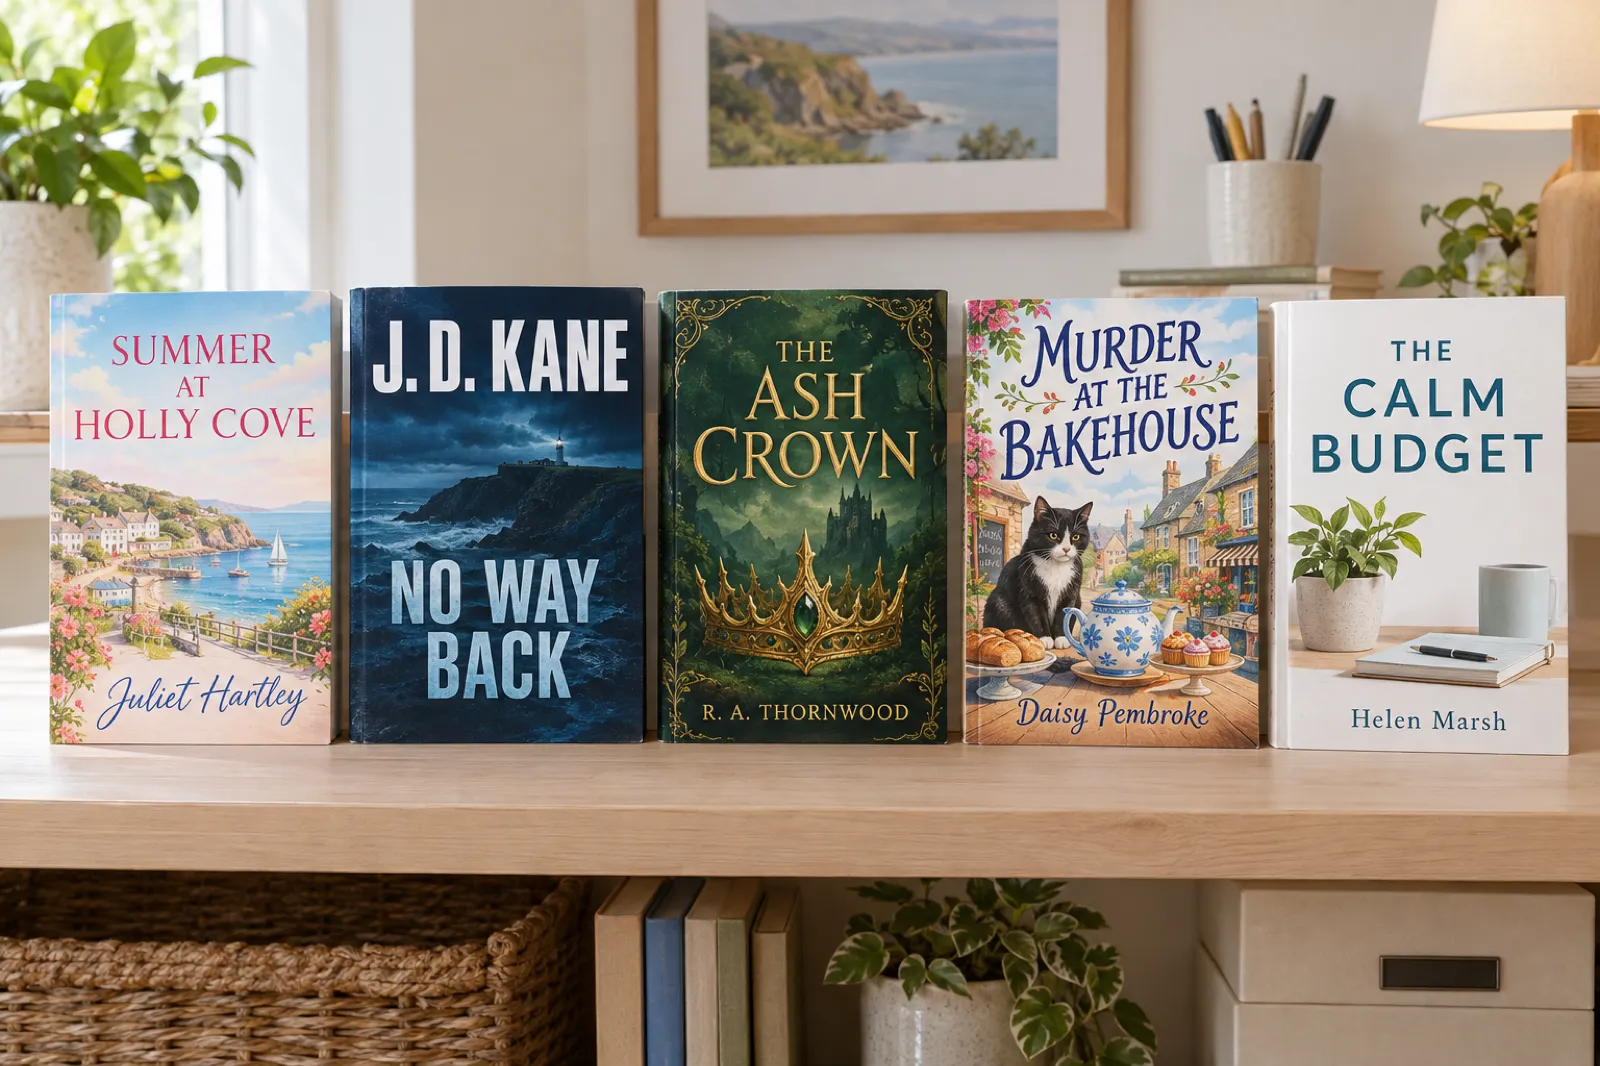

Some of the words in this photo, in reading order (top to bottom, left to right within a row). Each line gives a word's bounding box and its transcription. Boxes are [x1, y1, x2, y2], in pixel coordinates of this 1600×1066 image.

[111, 332, 275, 367] SUMMER
[371, 320, 417, 393] J.
[429, 320, 475, 393] D.
[492, 319, 629, 393] KANE
[775, 340, 834, 363] THE
[1020, 319, 1212, 388] MURDER
[1390, 339, 1452, 362] THE
[176, 375, 210, 398] AT
[745, 365, 866, 421] ASH
[1072, 381, 1109, 412] AT
[1116, 372, 1169, 406] THE
[1343, 377, 1504, 418] CALM
[74, 408, 201, 441] HOLLY
[212, 407, 316, 439] COVE
[999, 400, 1240, 482] BAKEHOUSE
[693, 426, 919, 488] CROWN
[1311, 433, 1543, 474] BUDGET
[391, 559, 460, 626] NO
[484, 558, 600, 625] WAY
[427, 630, 571, 700] BACK
[96, 677, 198, 731] Juliet
[200, 674, 307, 726] Hartley
[702, 704, 722, 721] R.
[729, 704, 750, 721] A.
[758, 703, 910, 722] THORNWOOD
[1016, 698, 1088, 735] Daisy
[1097, 697, 1210, 729] Pembroke
[1350, 708, 1421, 731] Helen
[1431, 710, 1507, 732] Marsh
